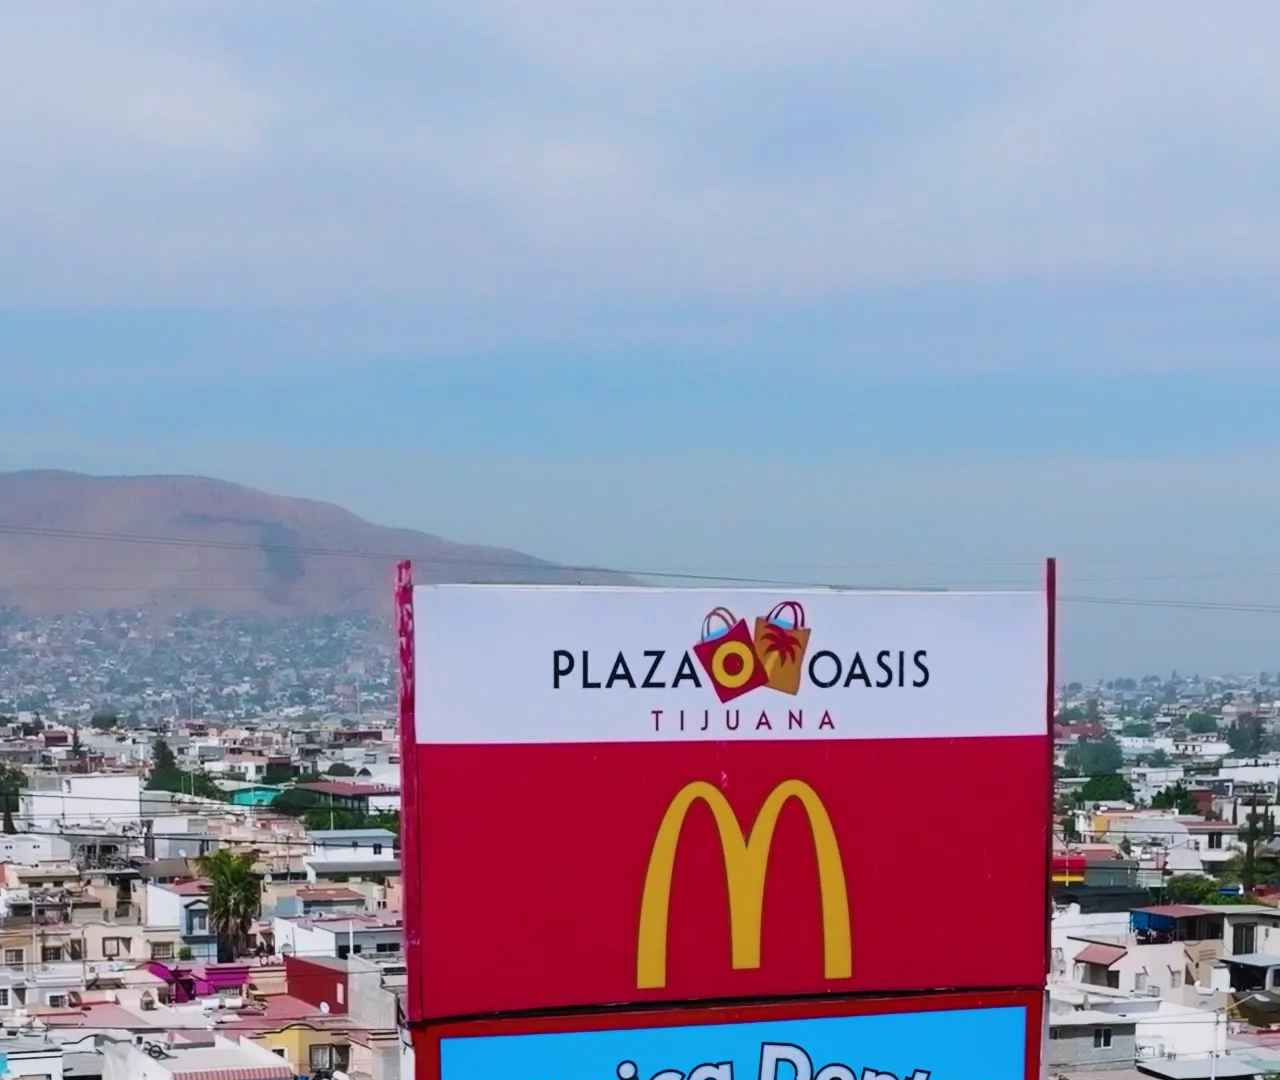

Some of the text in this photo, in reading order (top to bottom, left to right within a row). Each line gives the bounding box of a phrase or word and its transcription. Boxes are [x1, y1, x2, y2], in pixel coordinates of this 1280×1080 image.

[553, 649, 930, 689] PLAZA OASIS
[652, 708, 836, 732] TIJUANA
